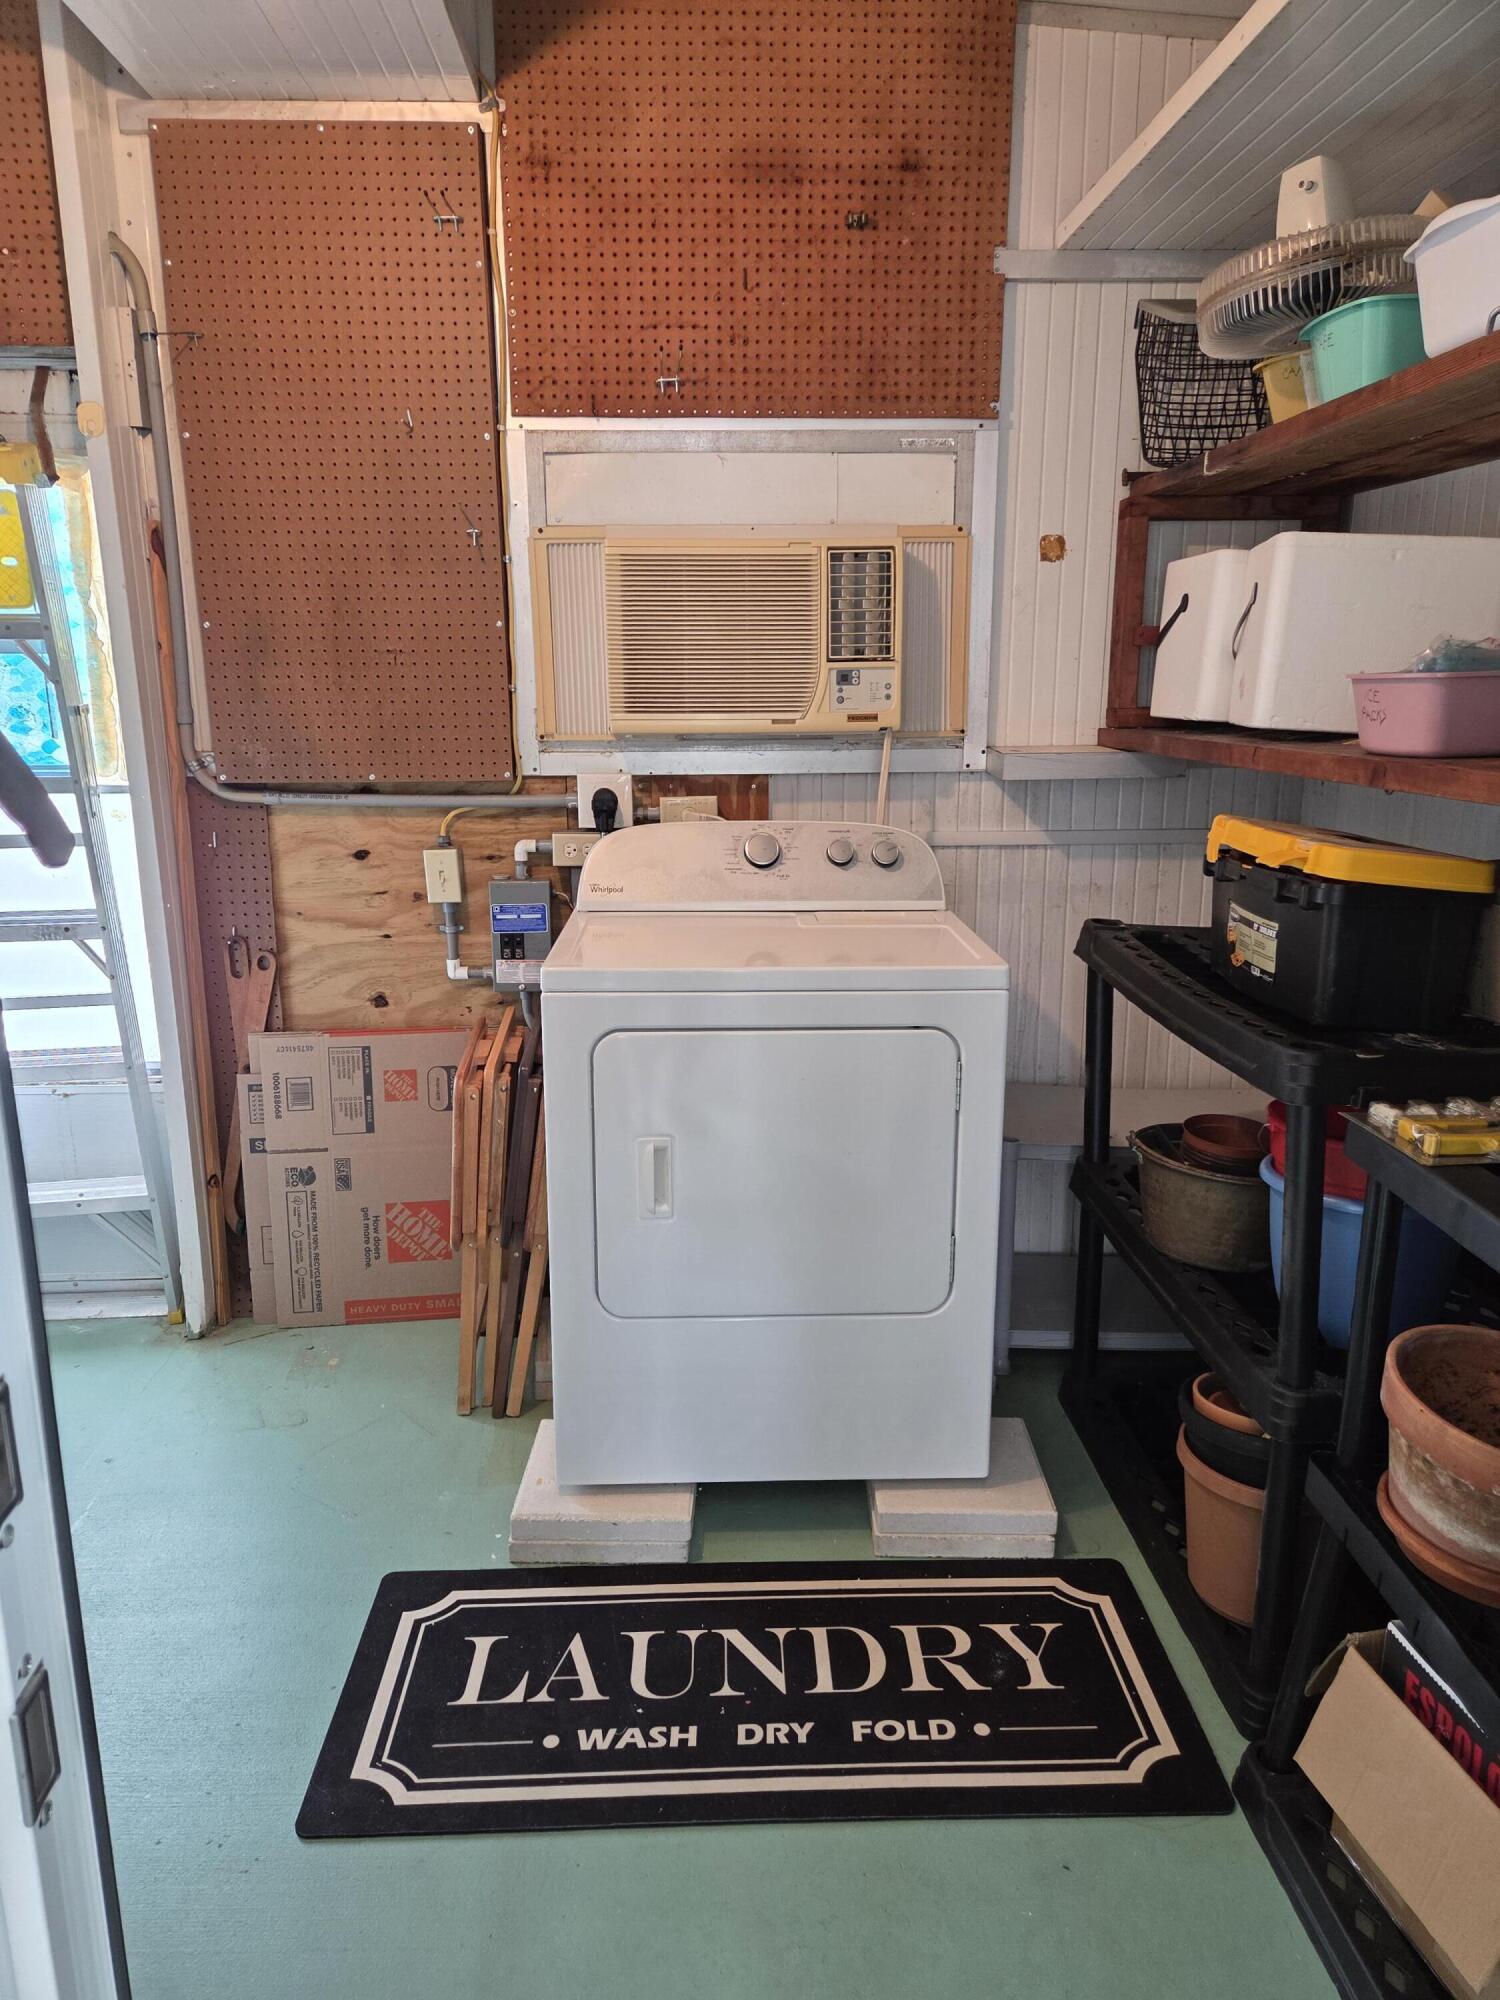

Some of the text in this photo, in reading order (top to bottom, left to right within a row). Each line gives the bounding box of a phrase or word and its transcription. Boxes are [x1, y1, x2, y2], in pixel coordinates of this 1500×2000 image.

[590, 886, 624, 895] Whirlpool
[272, 1072, 282, 1120] 1006188668
[290, 1167, 299, 1187] ECO
[360, 1207, 369, 1221] get
[386, 1202, 452, 1257] HOME
[418, 1206, 445, 1232] THE
[372, 1215, 381, 1260] How doers
[388, 1226, 430, 1260] DEPOT
[313, 1252, 321, 1288] RECYCLED
[315, 1290, 323, 1313] PAPER
[350, 1303, 386, 1315] HEAVY
[391, 1301, 421, 1312] DUTY
[447, 1622, 1065, 1706] LAUNDRY
[577, 1719, 957, 1751] WASH DRY FOLD
